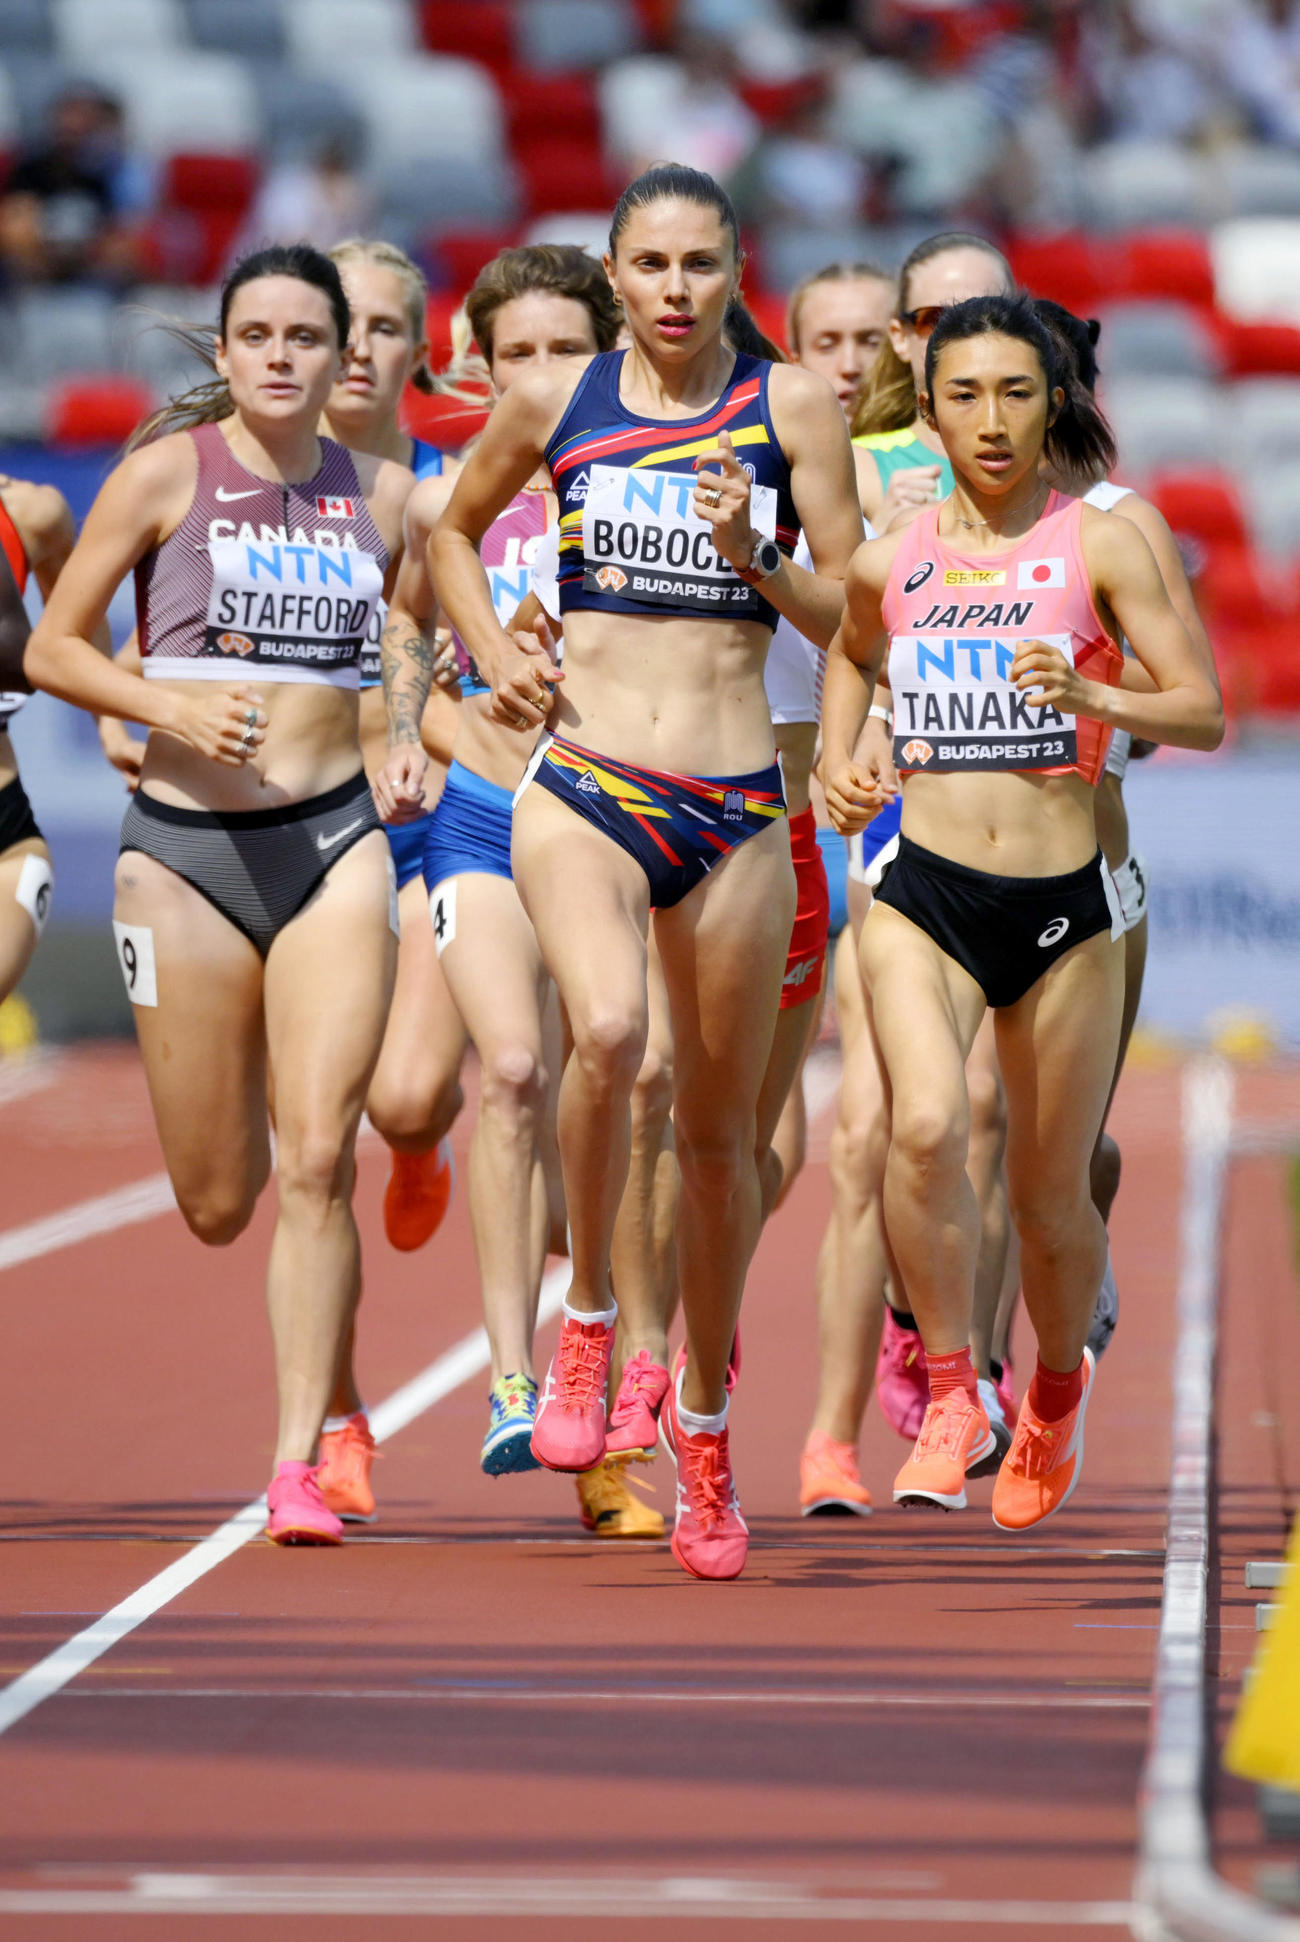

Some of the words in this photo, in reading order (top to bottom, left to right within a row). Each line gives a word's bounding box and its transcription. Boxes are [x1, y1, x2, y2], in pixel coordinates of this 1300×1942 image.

[566, 490, 588, 502] PEA
[623, 471, 704, 522] NT
[208, 518, 359, 550] CANADA
[246, 544, 353, 588] NTN
[945, 571, 1003, 584] SEIKO
[632, 575, 730, 601] BUDAPEST
[731, 586, 749, 601] 23
[217, 588, 369, 634] STAFFORD
[912, 602, 1035, 629] JAPAN
[258, 641, 342, 661] BUDAPEST
[902, 691, 1064, 731] TANAKA
[938, 743, 1041, 760] BUDAPEST
[1042, 740, 1064, 756] 23
[575, 781, 601, 794] PEAK
[723, 813, 743, 822] ROU
[433, 897, 447, 940] 4
[123, 938, 137, 989] 9
